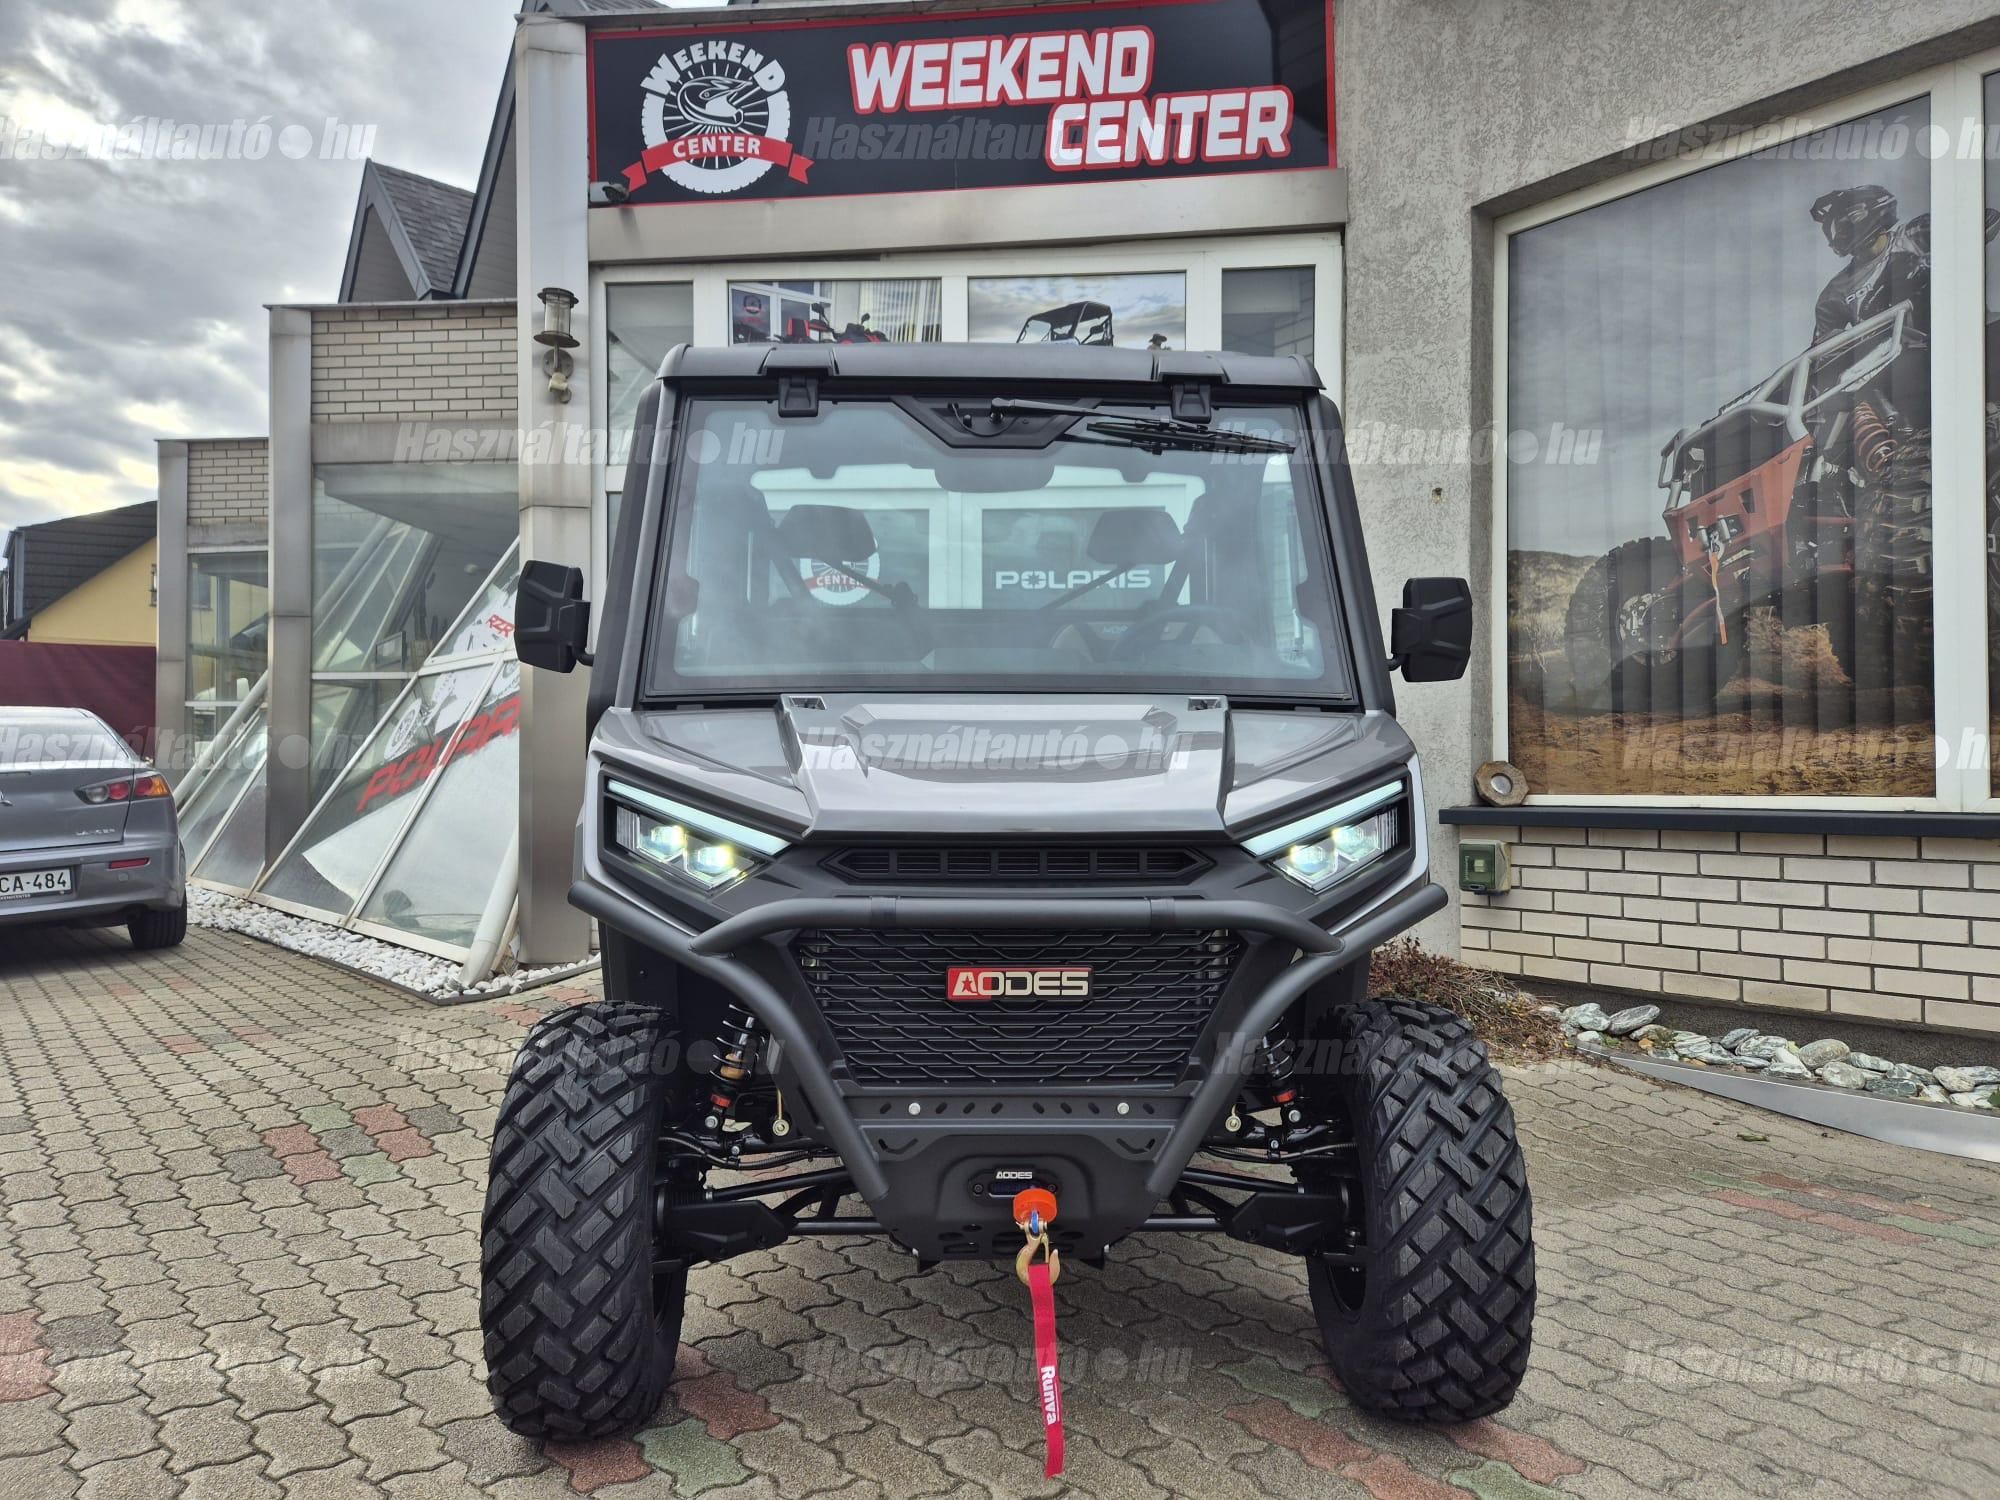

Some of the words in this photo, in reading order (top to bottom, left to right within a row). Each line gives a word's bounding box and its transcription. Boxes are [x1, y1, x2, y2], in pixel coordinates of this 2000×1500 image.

[640, 40, 786, 96] WEEKEND
[851, 28, 1150, 110] WEEKEND
[673, 135, 761, 158] CENTER
[1051, 89, 1289, 166] CENTER
[485, 614, 515, 638] RZR
[952, 972, 1089, 996] AODES
[996, 1171, 1033, 1179] AODES
[1041, 1366, 1057, 1425] Runva
